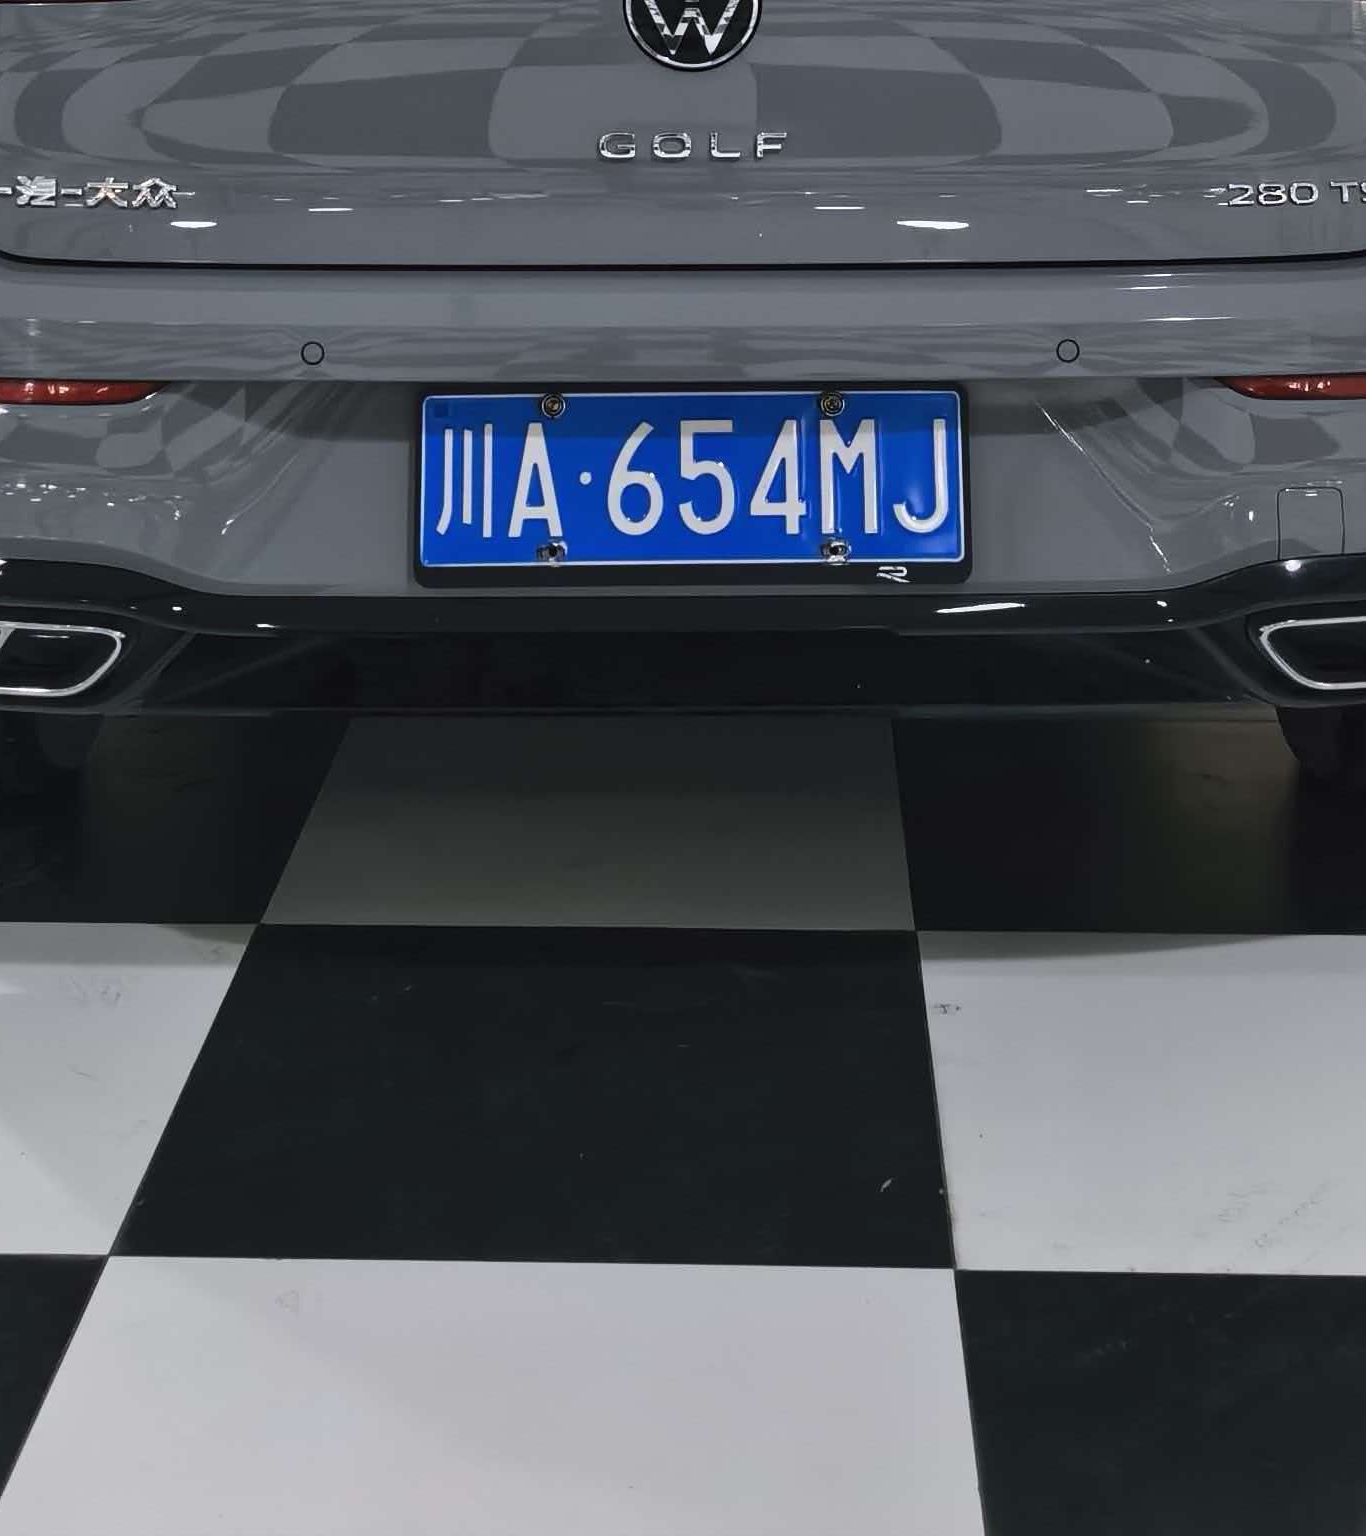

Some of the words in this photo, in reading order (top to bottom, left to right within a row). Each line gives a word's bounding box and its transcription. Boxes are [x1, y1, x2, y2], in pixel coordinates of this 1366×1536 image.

[598, 131, 788, 159] GOLF
[1227, 182, 1319, 206] 280
[436, 418, 949, 538] 川A·654MJ
